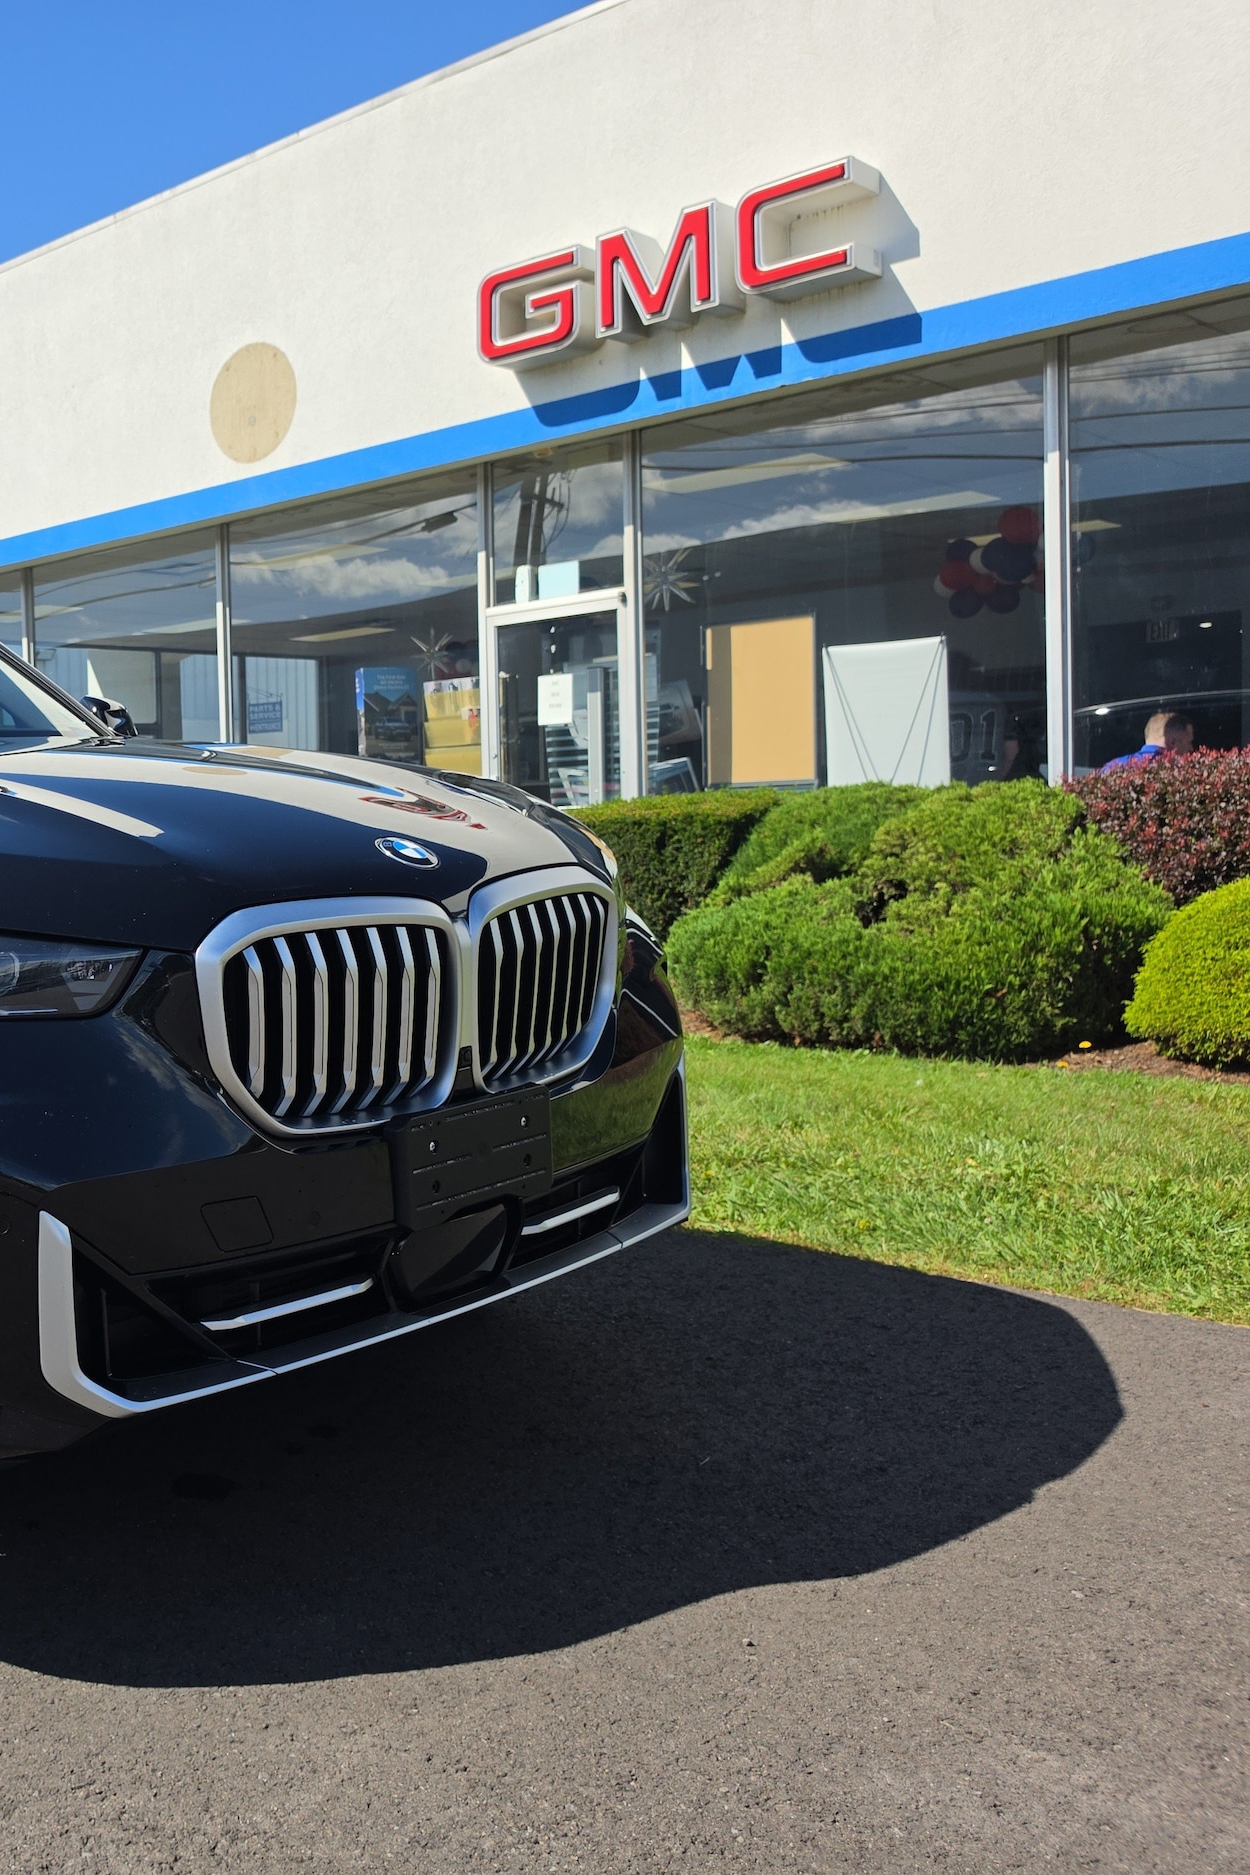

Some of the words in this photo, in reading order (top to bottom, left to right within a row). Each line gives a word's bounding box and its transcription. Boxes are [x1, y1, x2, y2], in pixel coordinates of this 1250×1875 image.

[477, 156, 882, 372] GMC
[249, 704, 273, 713] PARTS
[249, 711, 282, 720] SERVICE
